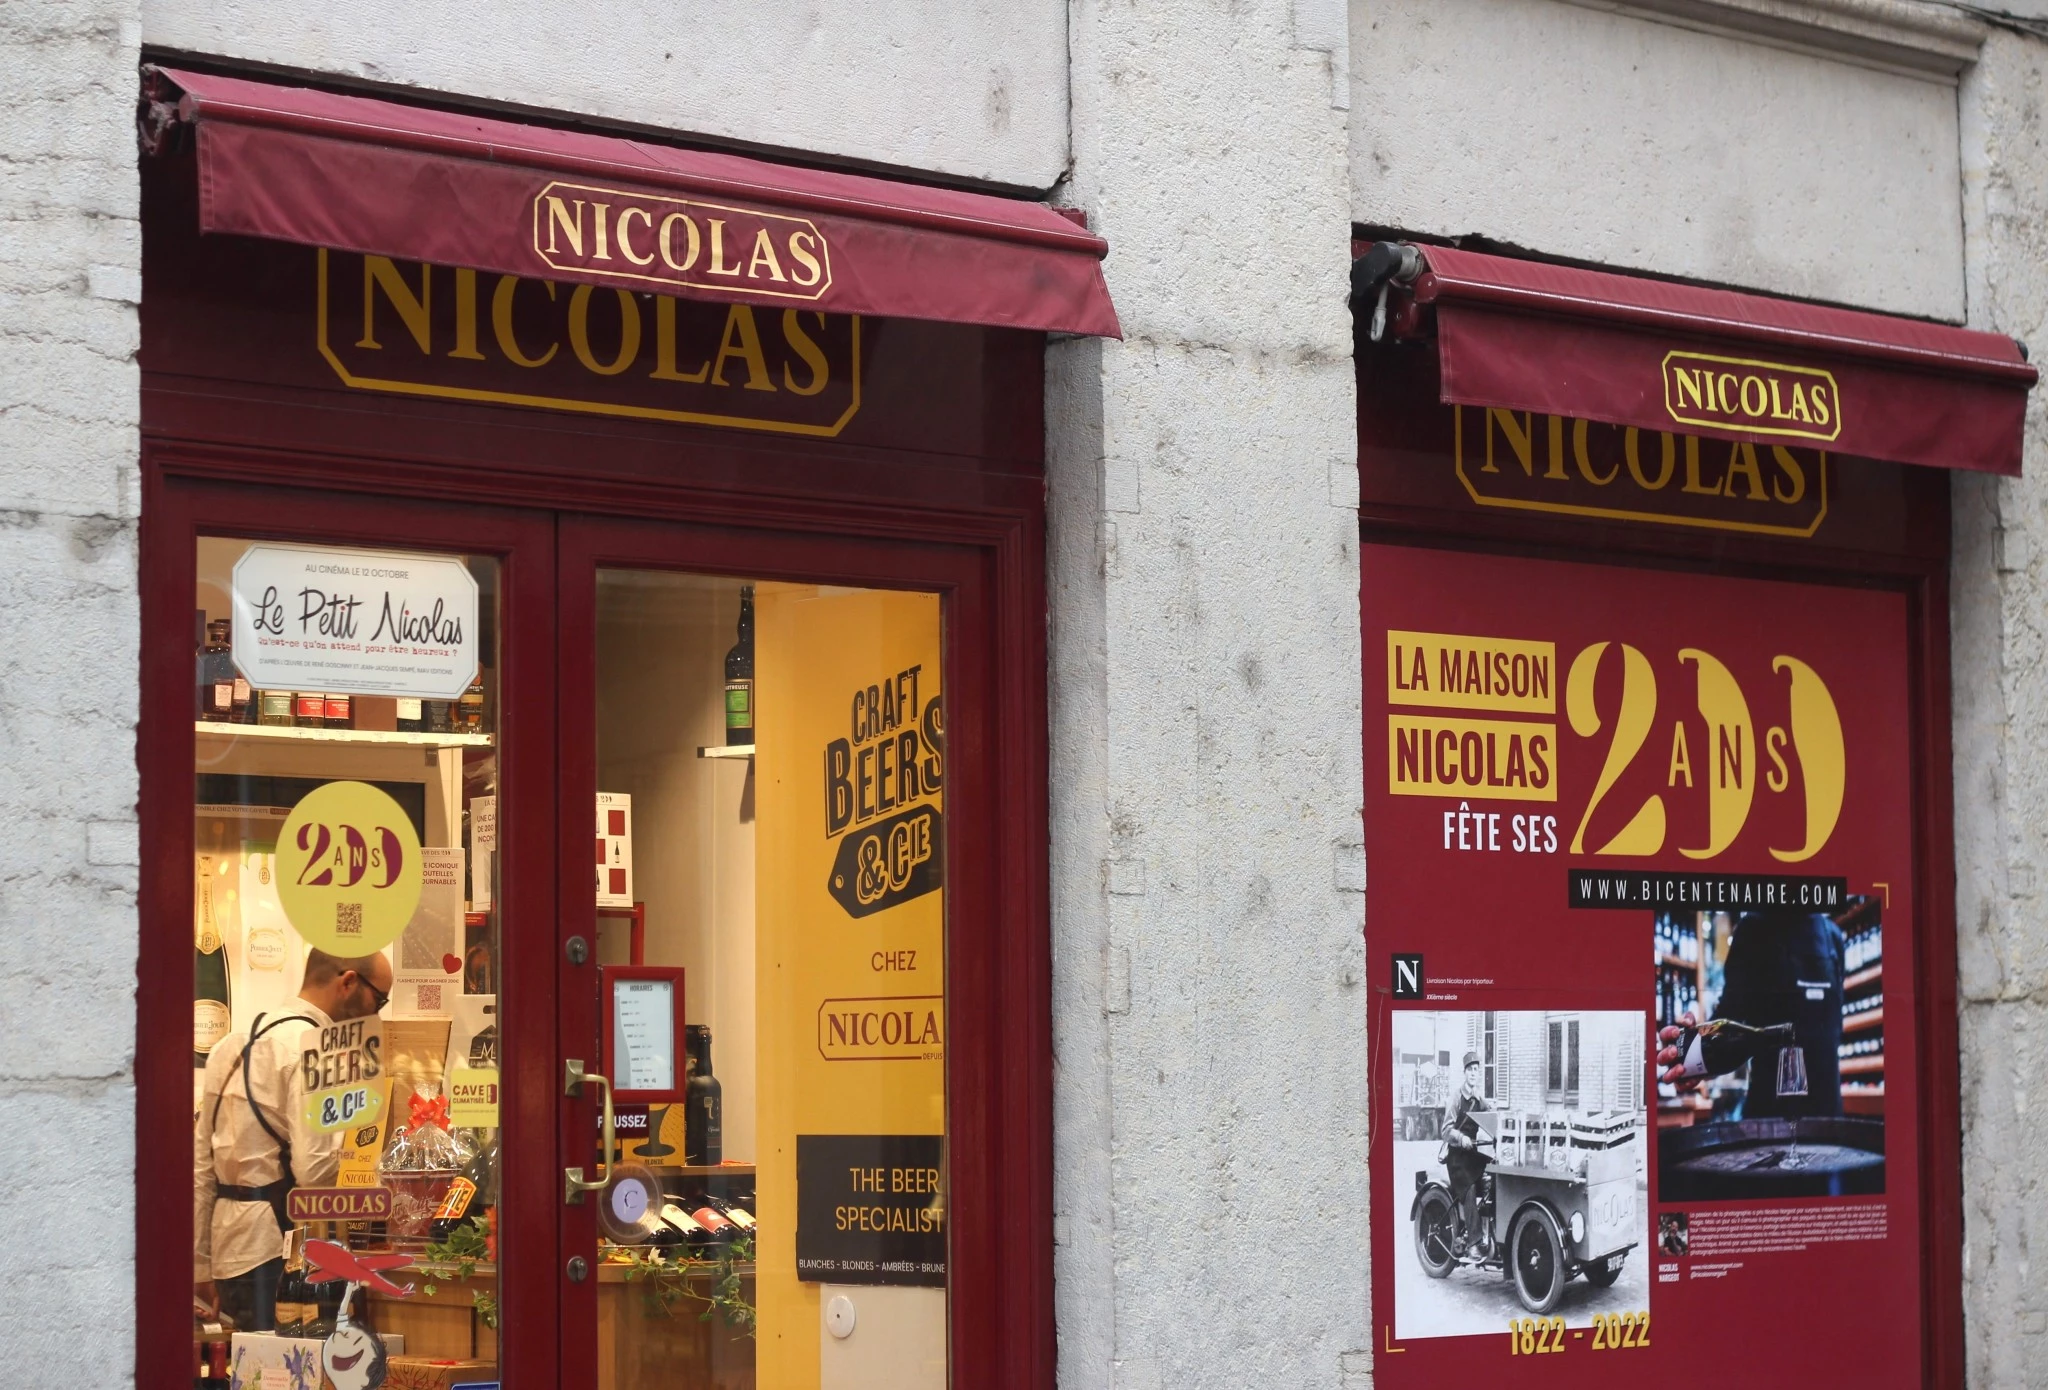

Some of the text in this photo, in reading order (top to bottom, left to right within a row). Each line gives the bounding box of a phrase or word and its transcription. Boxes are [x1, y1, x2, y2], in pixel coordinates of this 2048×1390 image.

[544, 196, 822, 287] NICOLAS
[354, 255, 829, 396] NICOLAS
[1673, 366, 1830, 426] NICOLAS
[1480, 407, 1806, 504] NICOLAS
[305, 564, 409, 579] AU CINÉMA LE 12 OCTOBRE
[251, 585, 463, 645] Le Petit Nicolas
[303, 640, 327, 650] qu'on
[331, 643, 361, 651] attend
[365, 645, 386, 654] pour
[389, 645, 409, 653] être
[412, 646, 449, 657] heureux
[1395, 645, 1550, 699] LA MAISON
[852, 663, 922, 746] CRAFT
[824, 695, 942, 840] BEERS
[1396, 727, 1550, 790] NICOLAS
[1668, 720, 1790, 793] ANS
[1443, 802, 1558, 854] FÊTE SES
[334, 846, 381, 868] ANS
[1580, 877, 1839, 906] WWW.BICENTENAIRE.COM
[871, 950, 917, 971] CHEZ
[630, 984, 653, 992] HORAIRES
[1395, 960, 1419, 993] N
[321, 1021, 364, 1053] CRAFT
[827, 1010, 942, 1046] NICOLA
[301, 1035, 380, 1096] BEERS
[922, 1052, 943, 1060] DEPUIS
[453, 1085, 485, 1096] CAVE
[597, 1114, 647, 1128] PUSSEZ
[329, 1150, 355, 1160] chez
[358, 1155, 372, 1163] CHEZ
[344, 1174, 375, 1184] NICOLAS
[850, 1167, 939, 1193] THE BEER
[293, 1194, 386, 1214] NICOLAS
[835, 1206, 944, 1233] SPECIALIST
[799, 1259, 835, 1269] BLANCHES
[842, 1260, 874, 1271] BLONDES
[881, 1260, 914, 1272] AMBRÉES
[921, 1263, 945, 1273] BRUNE
[1509, 1315, 1566, 1356] 1822
[1591, 1310, 1651, 1351] 2022
